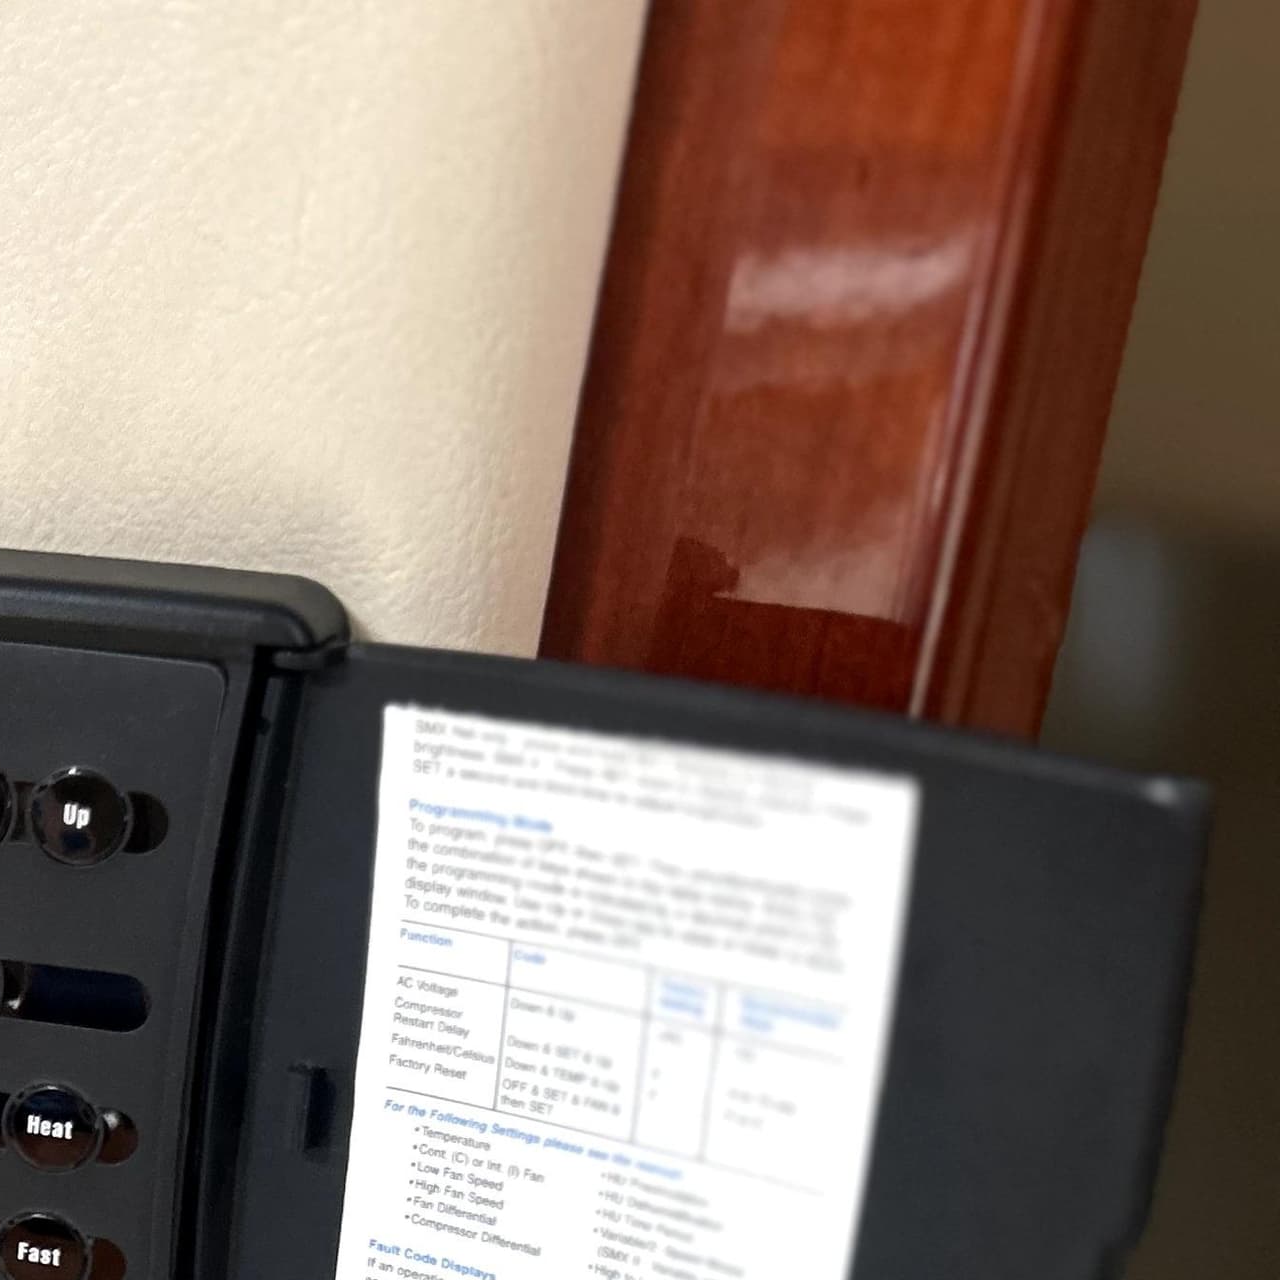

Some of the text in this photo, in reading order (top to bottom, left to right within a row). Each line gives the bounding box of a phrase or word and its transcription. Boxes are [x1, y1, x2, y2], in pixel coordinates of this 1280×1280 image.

[64, 804, 90, 829] Up
[410, 818, 425, 832] To
[408, 838, 428, 852] the
[407, 857, 427, 872] the
[405, 876, 452, 897] display
[404, 894, 510, 925] To complete the
[400, 928, 452, 946] Function
[397, 976, 458, 998] AC Voltage
[394, 996, 463, 1018] Compressor
[394, 1012, 470, 1039] Restart Delay
[392, 1033, 494, 1064] Fahrenheit/Celsius
[390, 1054, 467, 1080] Factory Reset
[505, 1056, 536, 1072] Down
[502, 1078, 527, 1092] OFF
[544, 1088, 567, 1101] SET
[501, 1095, 553, 1114] then SET
[27, 1115, 72, 1139] Heat
[384, 1100, 404, 1112] For
[408, 1106, 426, 1117] the
[430, 1110, 488, 1133] Following
[490, 1123, 540, 1144] Settings
[422, 1126, 490, 1151] Temperature
[415, 1162, 504, 1191] Low Fan Speed
[452, 1152, 469, 1166] (C)
[472, 1159, 484, 1167] or
[524, 1168, 544, 1182] Fan
[413, 1180, 504, 1210] High Fan Speed
[412, 1196, 496, 1226] Fan Differential
[410, 1214, 541, 1256] Compressor Differential
[18, 1242, 60, 1266] Fast
[368, 1258, 376, 1267] If
[378, 1263, 393, 1272] an
[369, 1239, 496, 1280] Fault Code Displays
[592, 1264, 620, 1280] High
